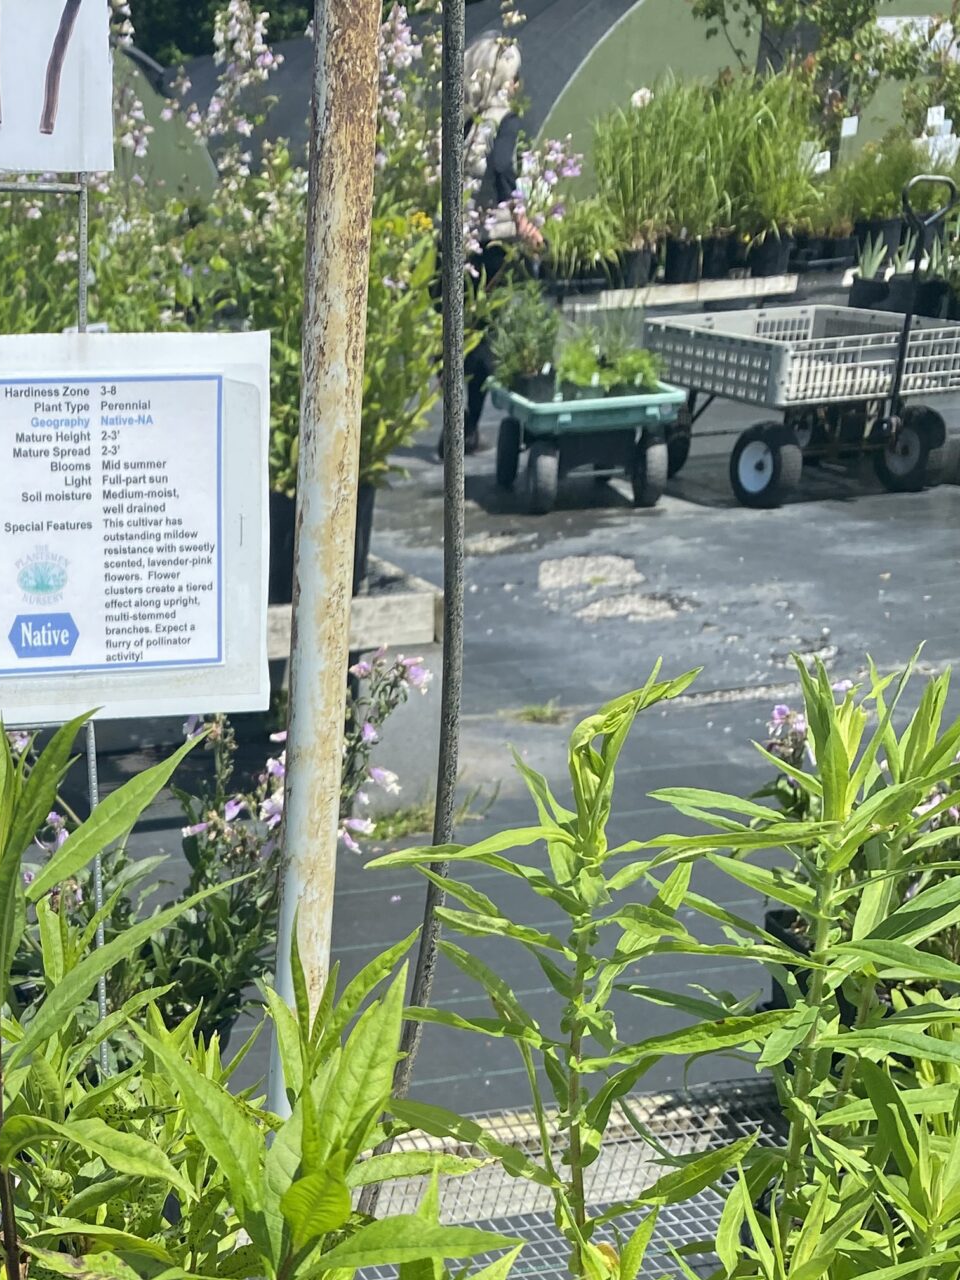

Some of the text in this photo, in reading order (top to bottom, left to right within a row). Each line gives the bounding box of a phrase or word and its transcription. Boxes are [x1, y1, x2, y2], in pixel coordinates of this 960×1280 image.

[4, 385, 117, 398] Hardiness Zone 3-8
[34, 400, 151, 414] Plant Type Perennial
[31, 415, 154, 429] Geography Native-NA
[15, 430, 120, 444] Mature Height 2-3'
[12, 445, 120, 459] Mature Spread 2-3'
[50, 460, 167, 472] Blooms Mid summer
[63, 474, 168, 488] Light Full-part sun
[21, 488, 180, 502] Soil moisture Medium-moist,
[103, 503, 166, 514] well drained
[4, 517, 183, 534] Special Features This cultivar has
[103, 529, 198, 543] outstanding mildew
[103, 542, 215, 556] resistance with sweetly
[104, 556, 213, 569] scented, lavender-pink
[104, 571, 181, 582] flowers. Flower
[104, 582, 213, 596] clusters create a tiered
[105, 595, 200, 609] effect along upright,
[105, 610, 177, 622] multi-stemmed
[21, 622, 70, 648] Native
[105, 623, 196, 635] branches. Expect a
[105, 636, 192, 650] flurry of pollinator
